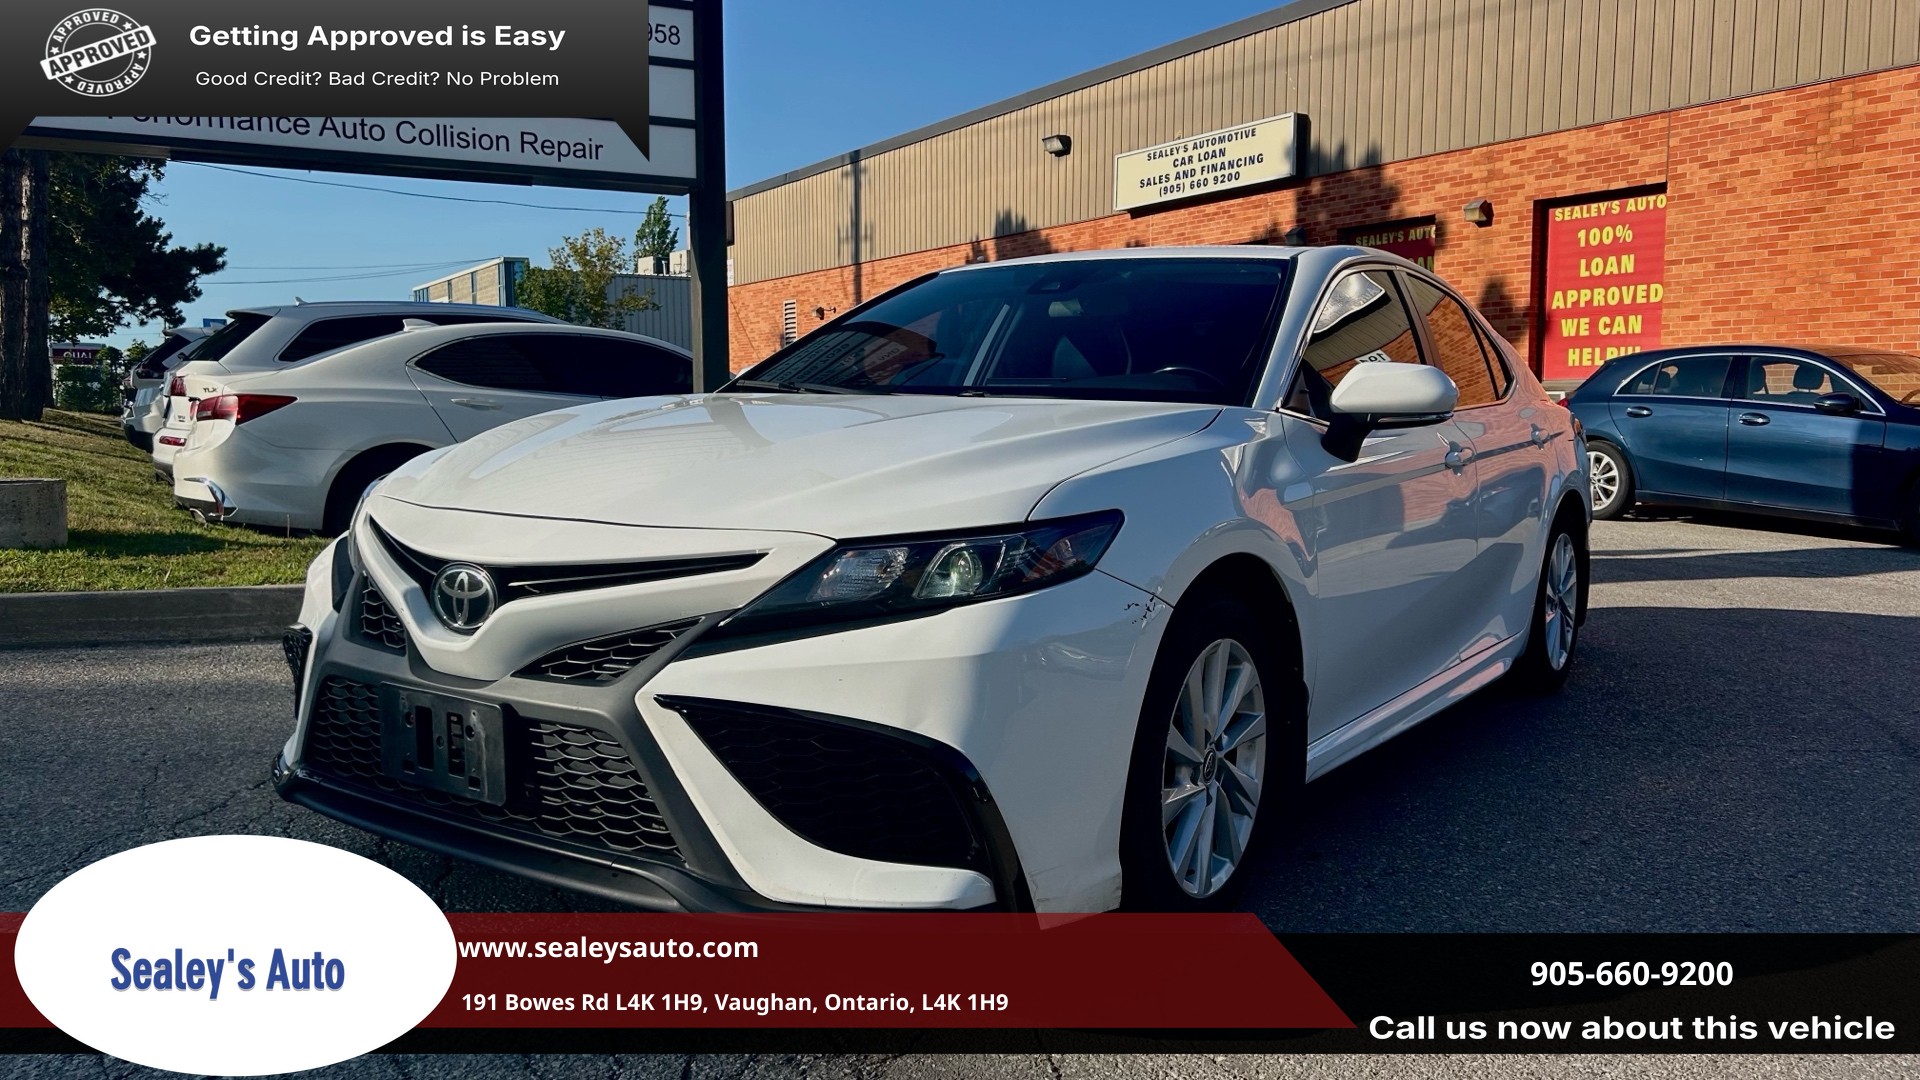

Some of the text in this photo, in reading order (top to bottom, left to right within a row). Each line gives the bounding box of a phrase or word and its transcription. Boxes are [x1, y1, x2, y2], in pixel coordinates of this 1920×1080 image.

[318, 116, 386, 142] Auto
[395, 120, 510, 152] Collision
[519, 131, 604, 162] Repair
[1147, 128, 1257, 161] SEALEY'S AUTOMOTIVE
[1139, 153, 1264, 188] SALES AND FINANCING
[1173, 147, 1227, 168] CAR LOAN
[1159, 171, 1241, 197] (905) 660 9200
[1554, 194, 1667, 221] SEALEY'S AUTO
[1355, 231, 1404, 246] SEALEY'S
[1577, 224, 1633, 247] 100%
[1579, 254, 1635, 277] LOAN
[1551, 283, 1664, 309] APPROVED
[1561, 314, 1642, 337] WE CAN
